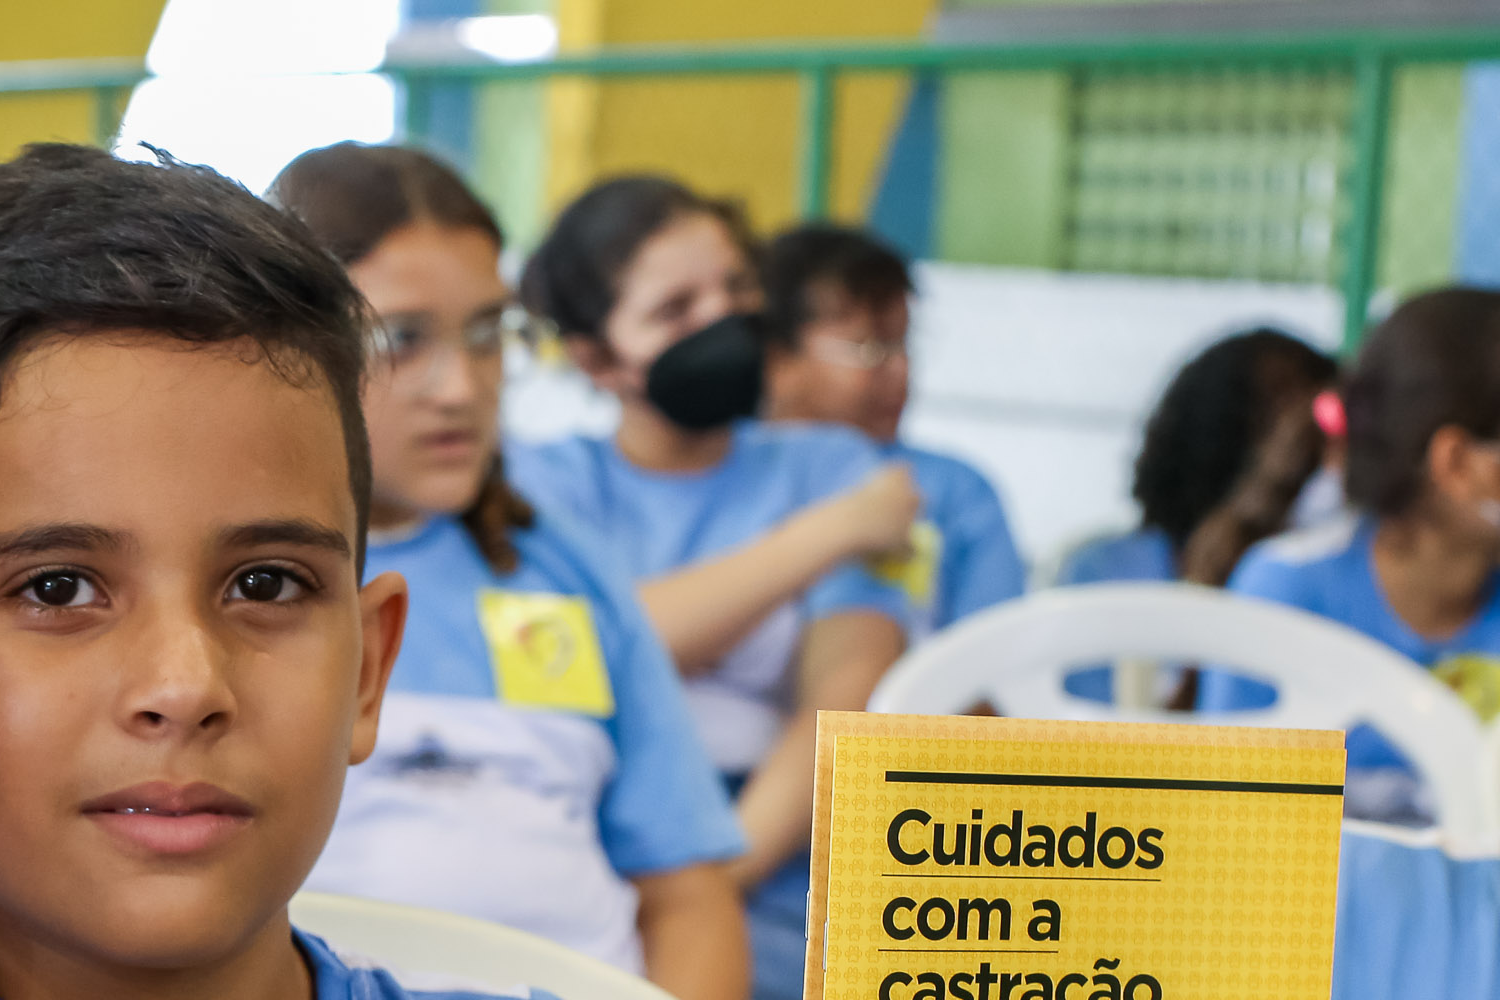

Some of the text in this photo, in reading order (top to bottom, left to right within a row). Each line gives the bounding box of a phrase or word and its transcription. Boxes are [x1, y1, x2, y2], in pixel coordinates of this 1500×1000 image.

[886, 809, 1165, 870] Cuidados
[882, 897, 1062, 942] com a
